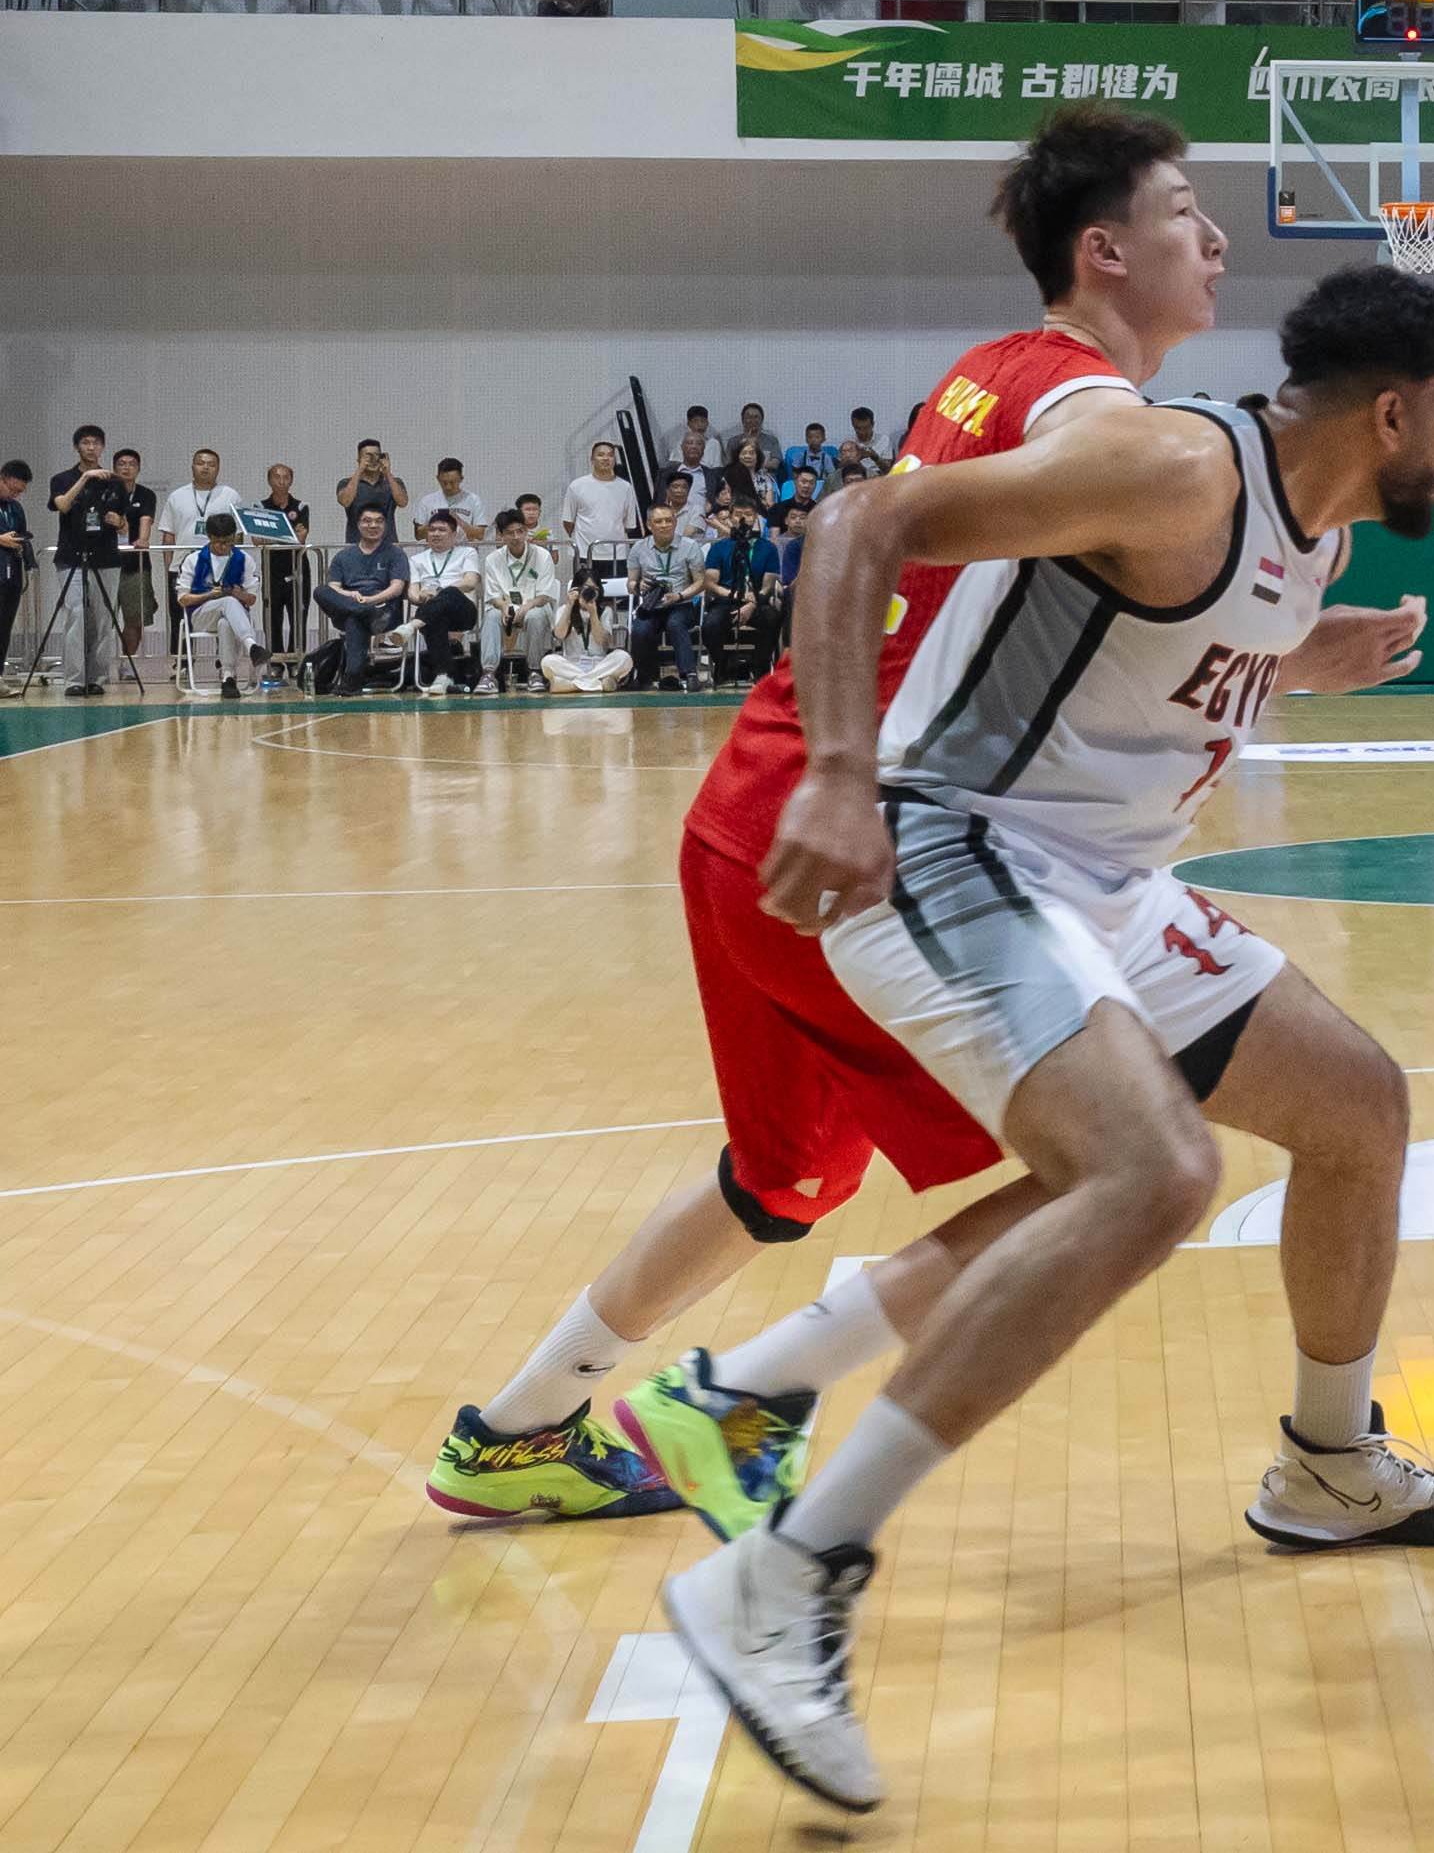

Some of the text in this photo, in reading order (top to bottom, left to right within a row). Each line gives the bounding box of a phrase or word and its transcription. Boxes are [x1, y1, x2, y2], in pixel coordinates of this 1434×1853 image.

[842, 61, 1004, 99] 千年儒城
[1020, 63, 1179, 101] 古郡犍为
[1166, 643, 1279, 729] EGYP
